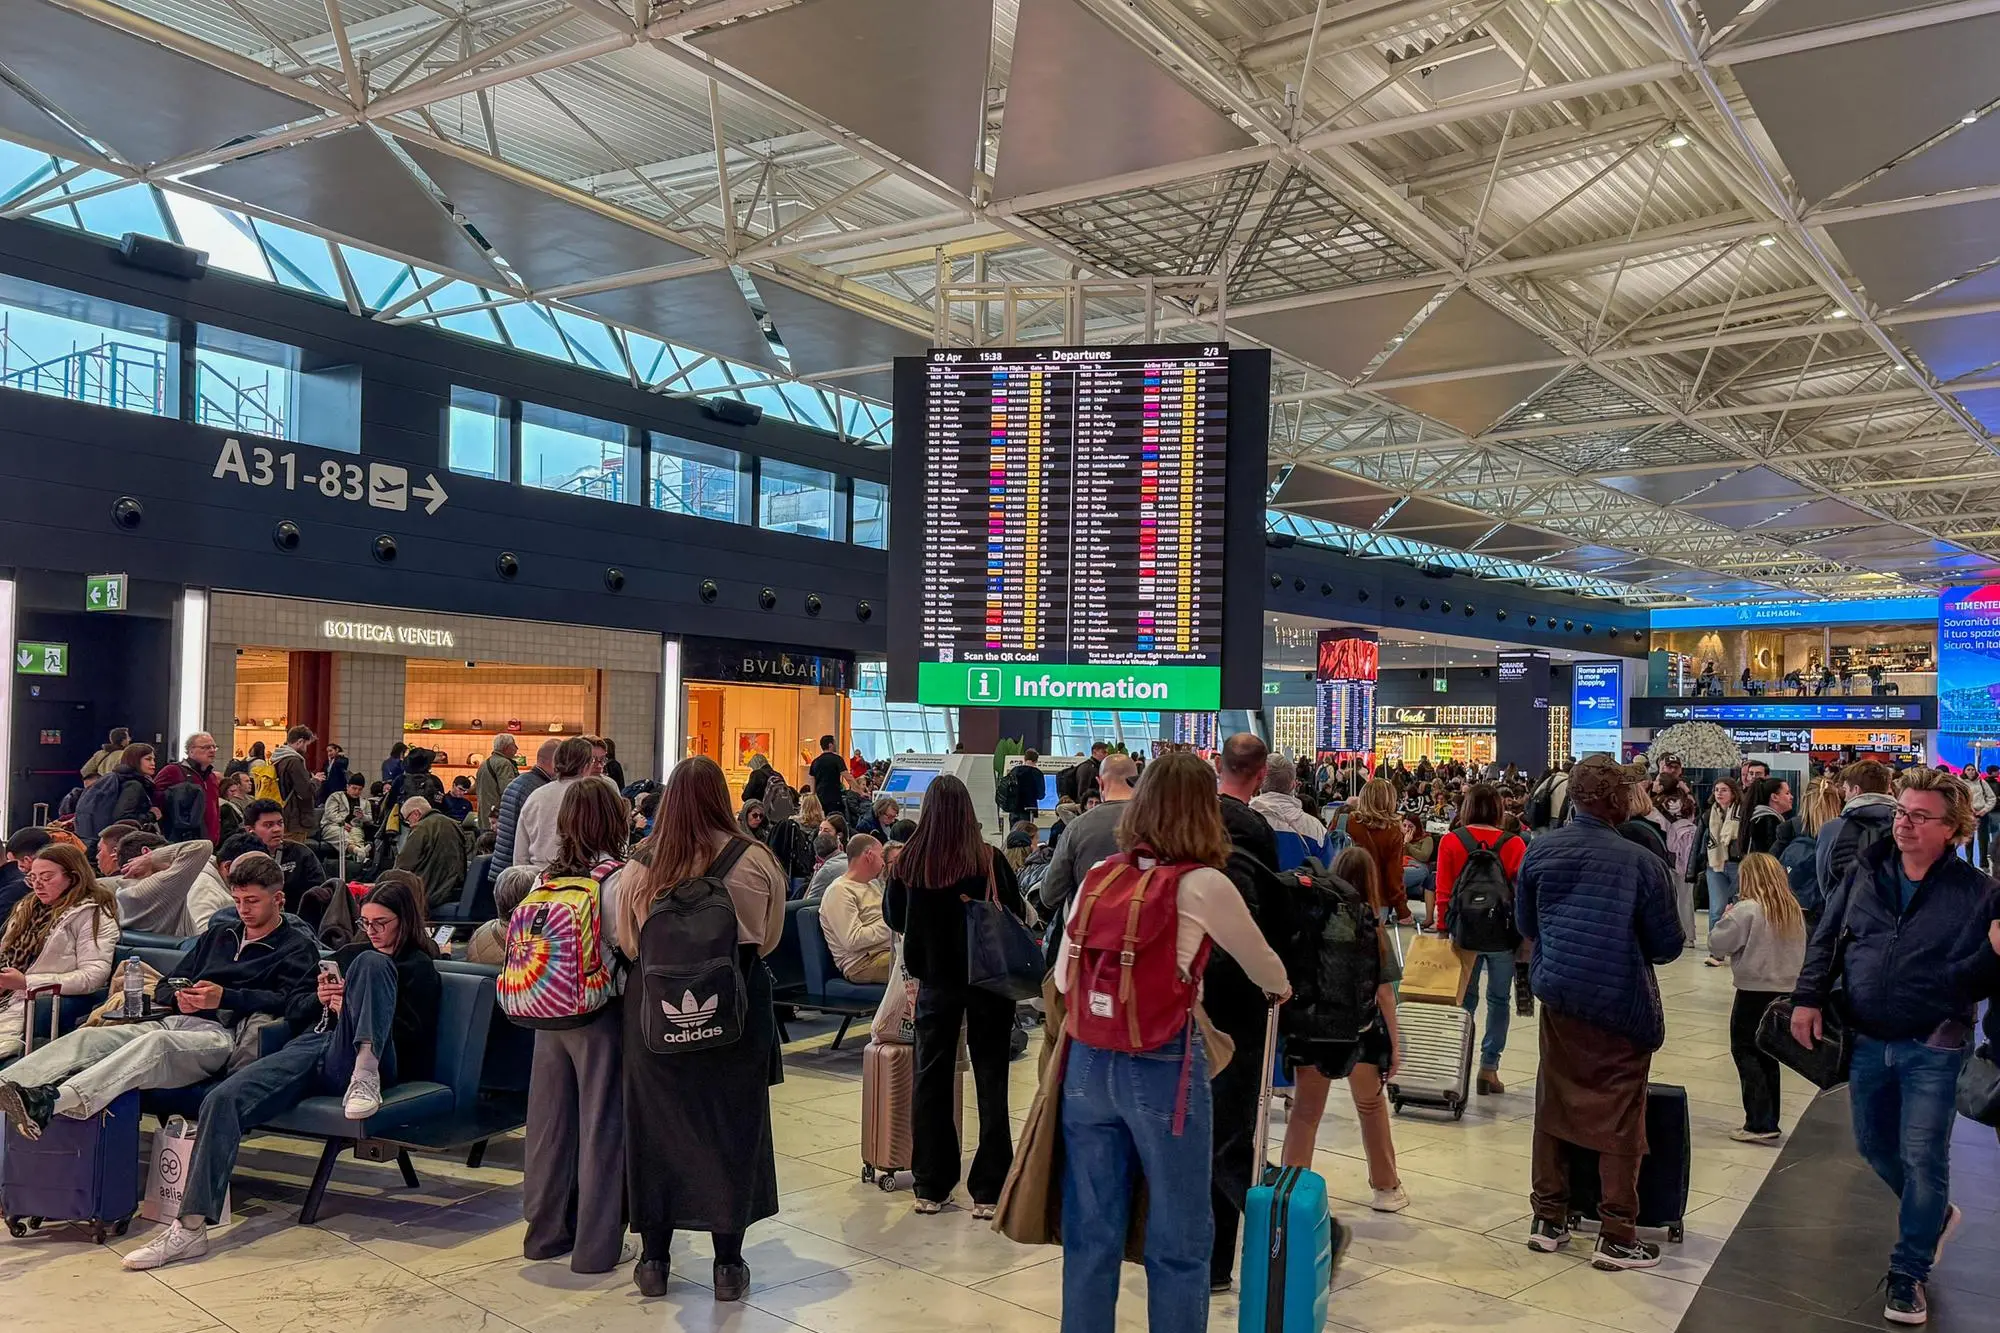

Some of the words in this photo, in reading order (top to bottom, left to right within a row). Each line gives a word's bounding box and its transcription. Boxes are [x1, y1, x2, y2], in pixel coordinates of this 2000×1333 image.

[1052, 350, 1112, 362] Departures
[1203, 347, 1219, 356] 2/3
[934, 353, 945, 362] 02
[946, 353, 962, 363] Apr
[979, 352, 1003, 362] 15:38
[212, 437, 364, 501] A31-83
[1954, 602, 1972, 610] TIM
[1943, 616, 1990, 628] Sovranità
[324, 620, 394, 642] BOTTEGA
[398, 626, 454, 647] VENETA
[1943, 629, 1949, 639] il
[1951, 630, 1968, 639] tuo
[1943, 641, 1974, 650] sicuro.
[1975, 640, 1985, 649] In
[964, 653, 983, 661] Scan
[985, 653, 999, 661] the
[1000, 653, 1014, 662] QR
[1015, 653, 1039, 661] Code!
[1596, 666, 1617, 675] airport
[1015, 674, 1168, 699] Information
[1578, 679, 1606, 687] shopping
[1395, 708, 1426, 723] Venchi
[663, 1024, 724, 1043] adidas
[160, 1186, 183, 1201] aelia
